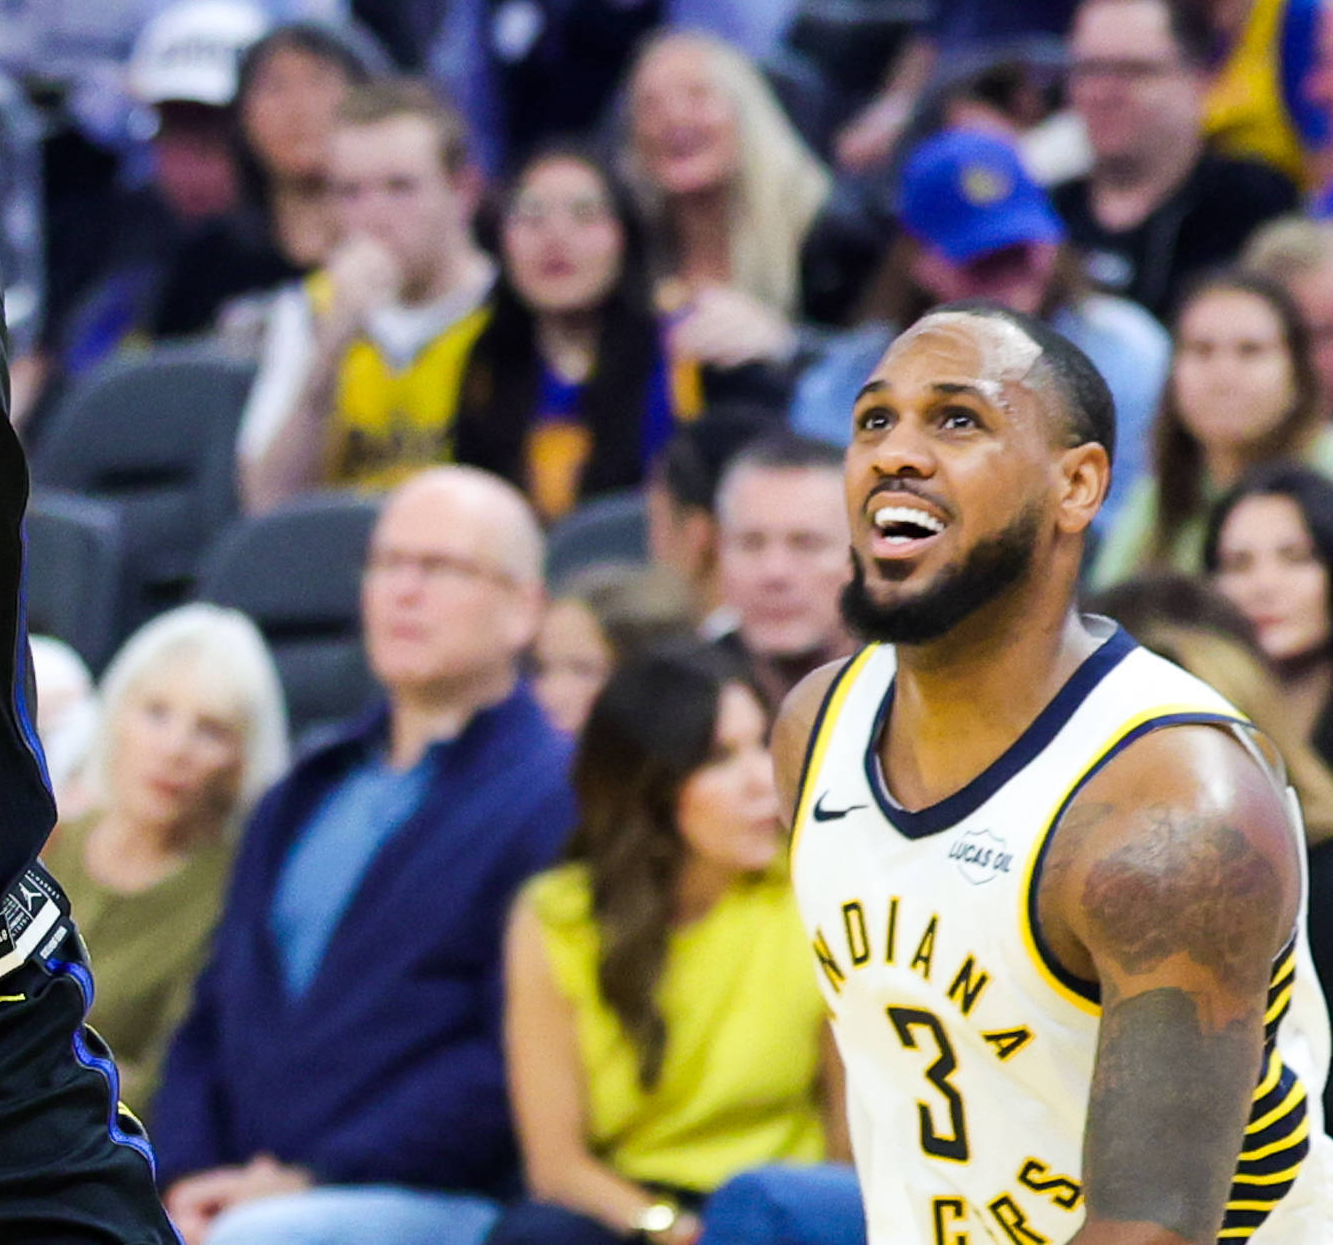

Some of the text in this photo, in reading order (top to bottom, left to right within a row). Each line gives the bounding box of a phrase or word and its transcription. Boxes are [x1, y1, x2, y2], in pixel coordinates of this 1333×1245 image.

[948, 840, 993, 867] LUCAS
[814, 896, 1033, 1061] NDIANA
[886, 1004, 970, 1165] 3
